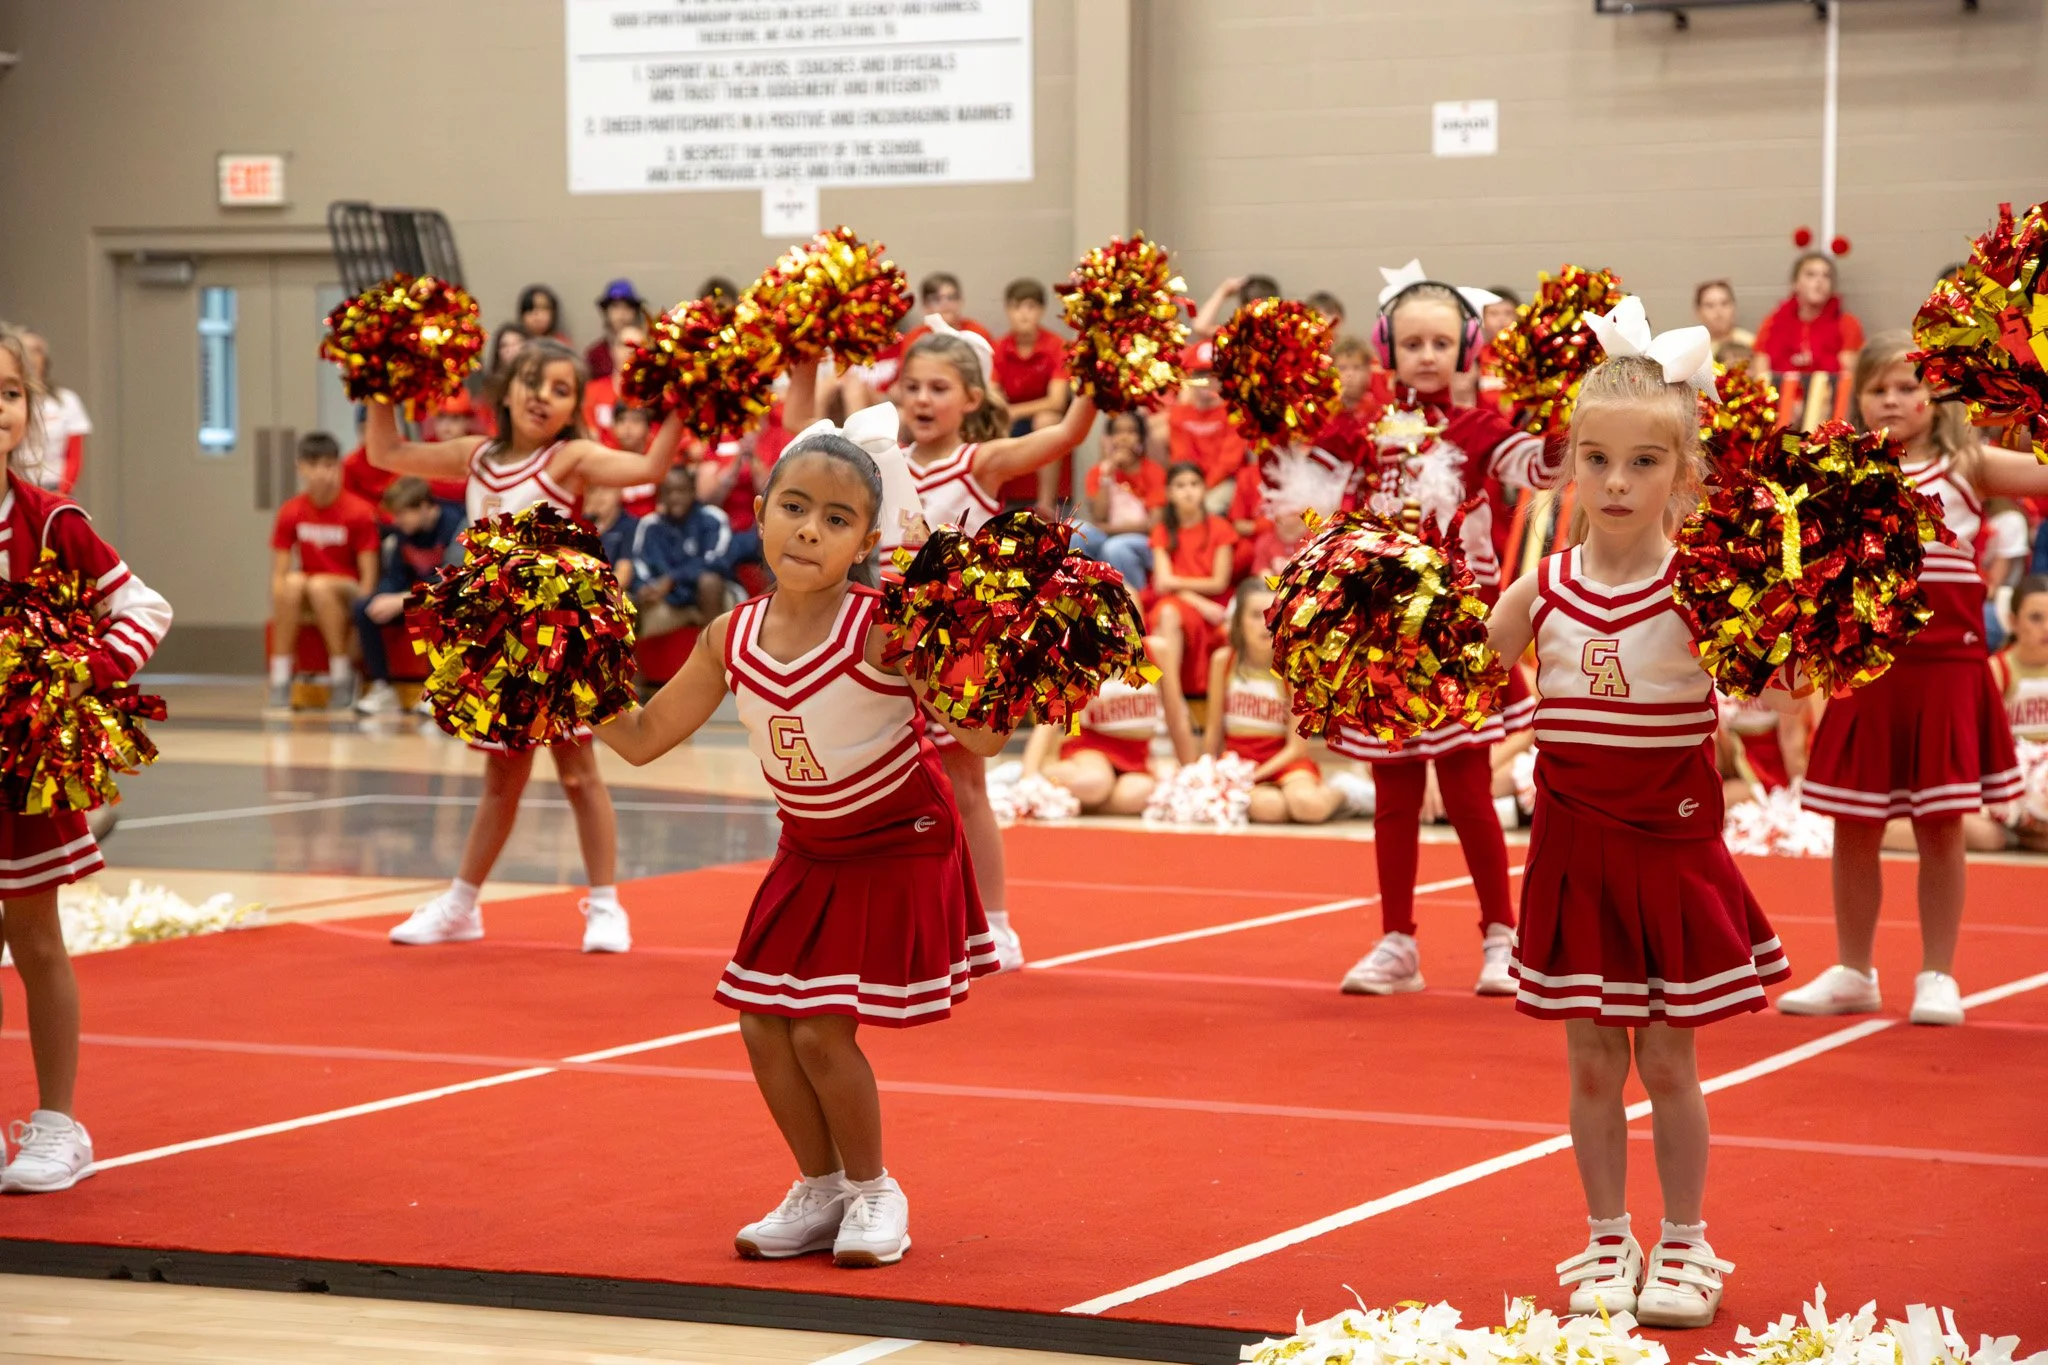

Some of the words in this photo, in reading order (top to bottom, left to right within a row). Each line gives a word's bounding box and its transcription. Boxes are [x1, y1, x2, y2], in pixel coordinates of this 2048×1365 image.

[648, 62, 702, 81] SUPPORT
[706, 61, 730, 79] ALL
[797, 57, 856, 76] COACHES
[860, 56, 886, 74] AND
[890, 53, 957, 72] OFFICIALS
[650, 84, 675, 102] AND
[679, 82, 716, 102] TRUST
[725, 81, 760, 100] THEIR
[843, 78, 869, 96] AND
[872, 75, 942, 95] INTEGRITY
[602, 115, 642, 135] CHEER
[646, 111, 737, 133] PARTICIPANTS
[769, 109, 826, 130] POSITIVE
[831, 108, 855, 127] AND
[859, 105, 951, 126] ENCOURAGING
[957, 102, 1013, 123] MANNER
[682, 143, 738, 162] RESPECT
[743, 143, 763, 159] THE
[768, 141, 830, 159] PROPERTY
[228, 162, 270, 195] EXIT
[648, 164, 670, 182] AND
[674, 163, 705, 181] HELP
[708, 162, 755, 181] PROVIDE
[774, 160, 804, 179] SAFE
[807, 160, 830, 178] AND
[833, 159, 857, 177] FUN
[860, 157, 949, 176] ENVIRONMENT
[1581, 638, 1630, 698] CA
[768, 715, 828, 782] CA
